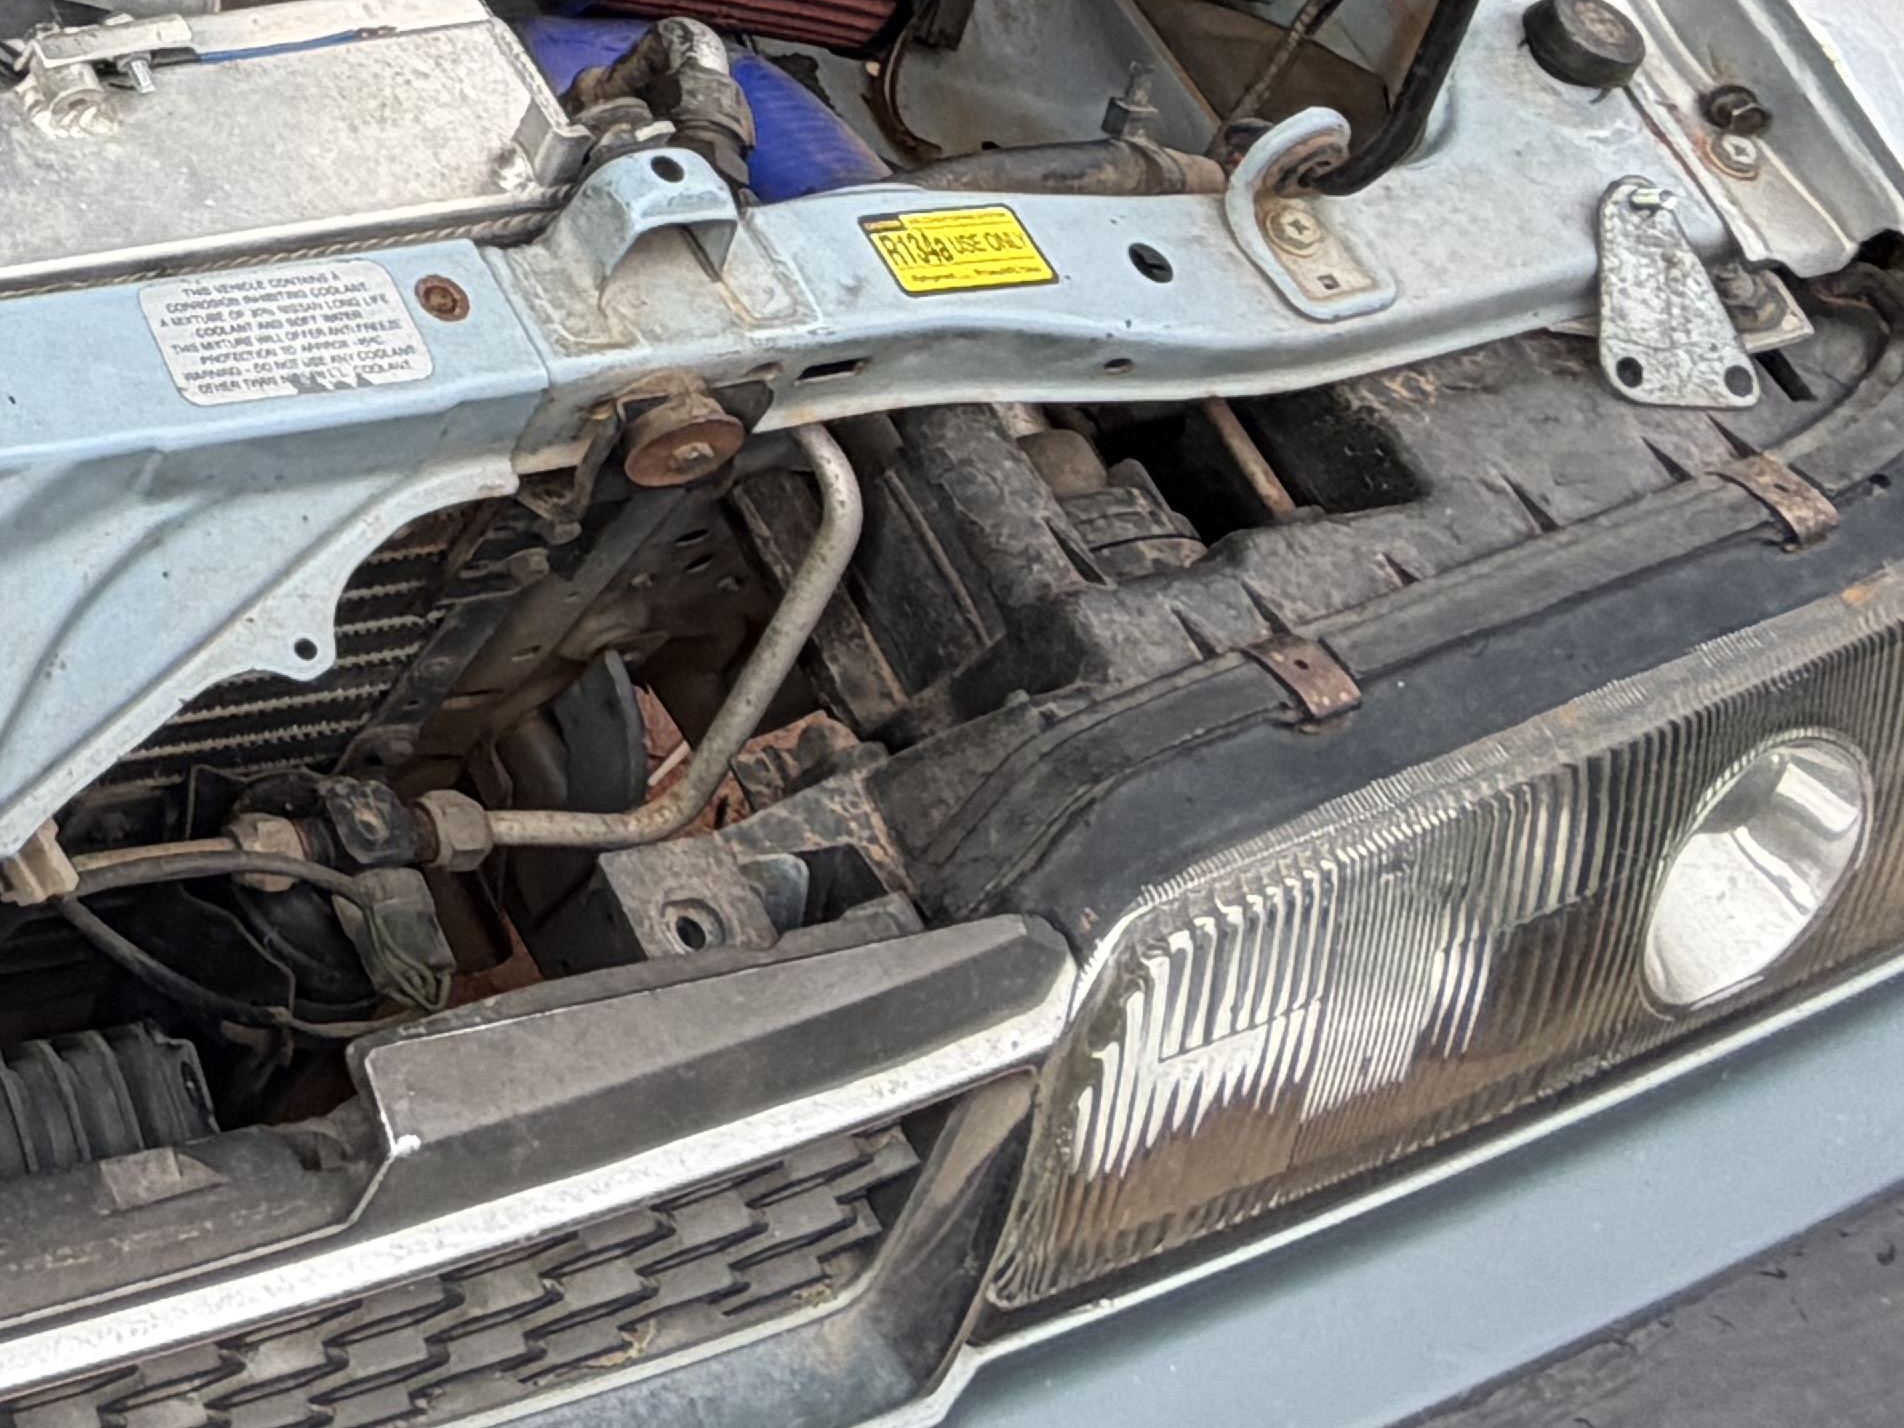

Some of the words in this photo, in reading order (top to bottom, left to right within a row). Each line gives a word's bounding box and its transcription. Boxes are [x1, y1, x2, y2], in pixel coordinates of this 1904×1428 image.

[878, 227, 956, 267] R134a
[948, 232, 988, 255] USE
[983, 230, 1028, 253] ONLY
